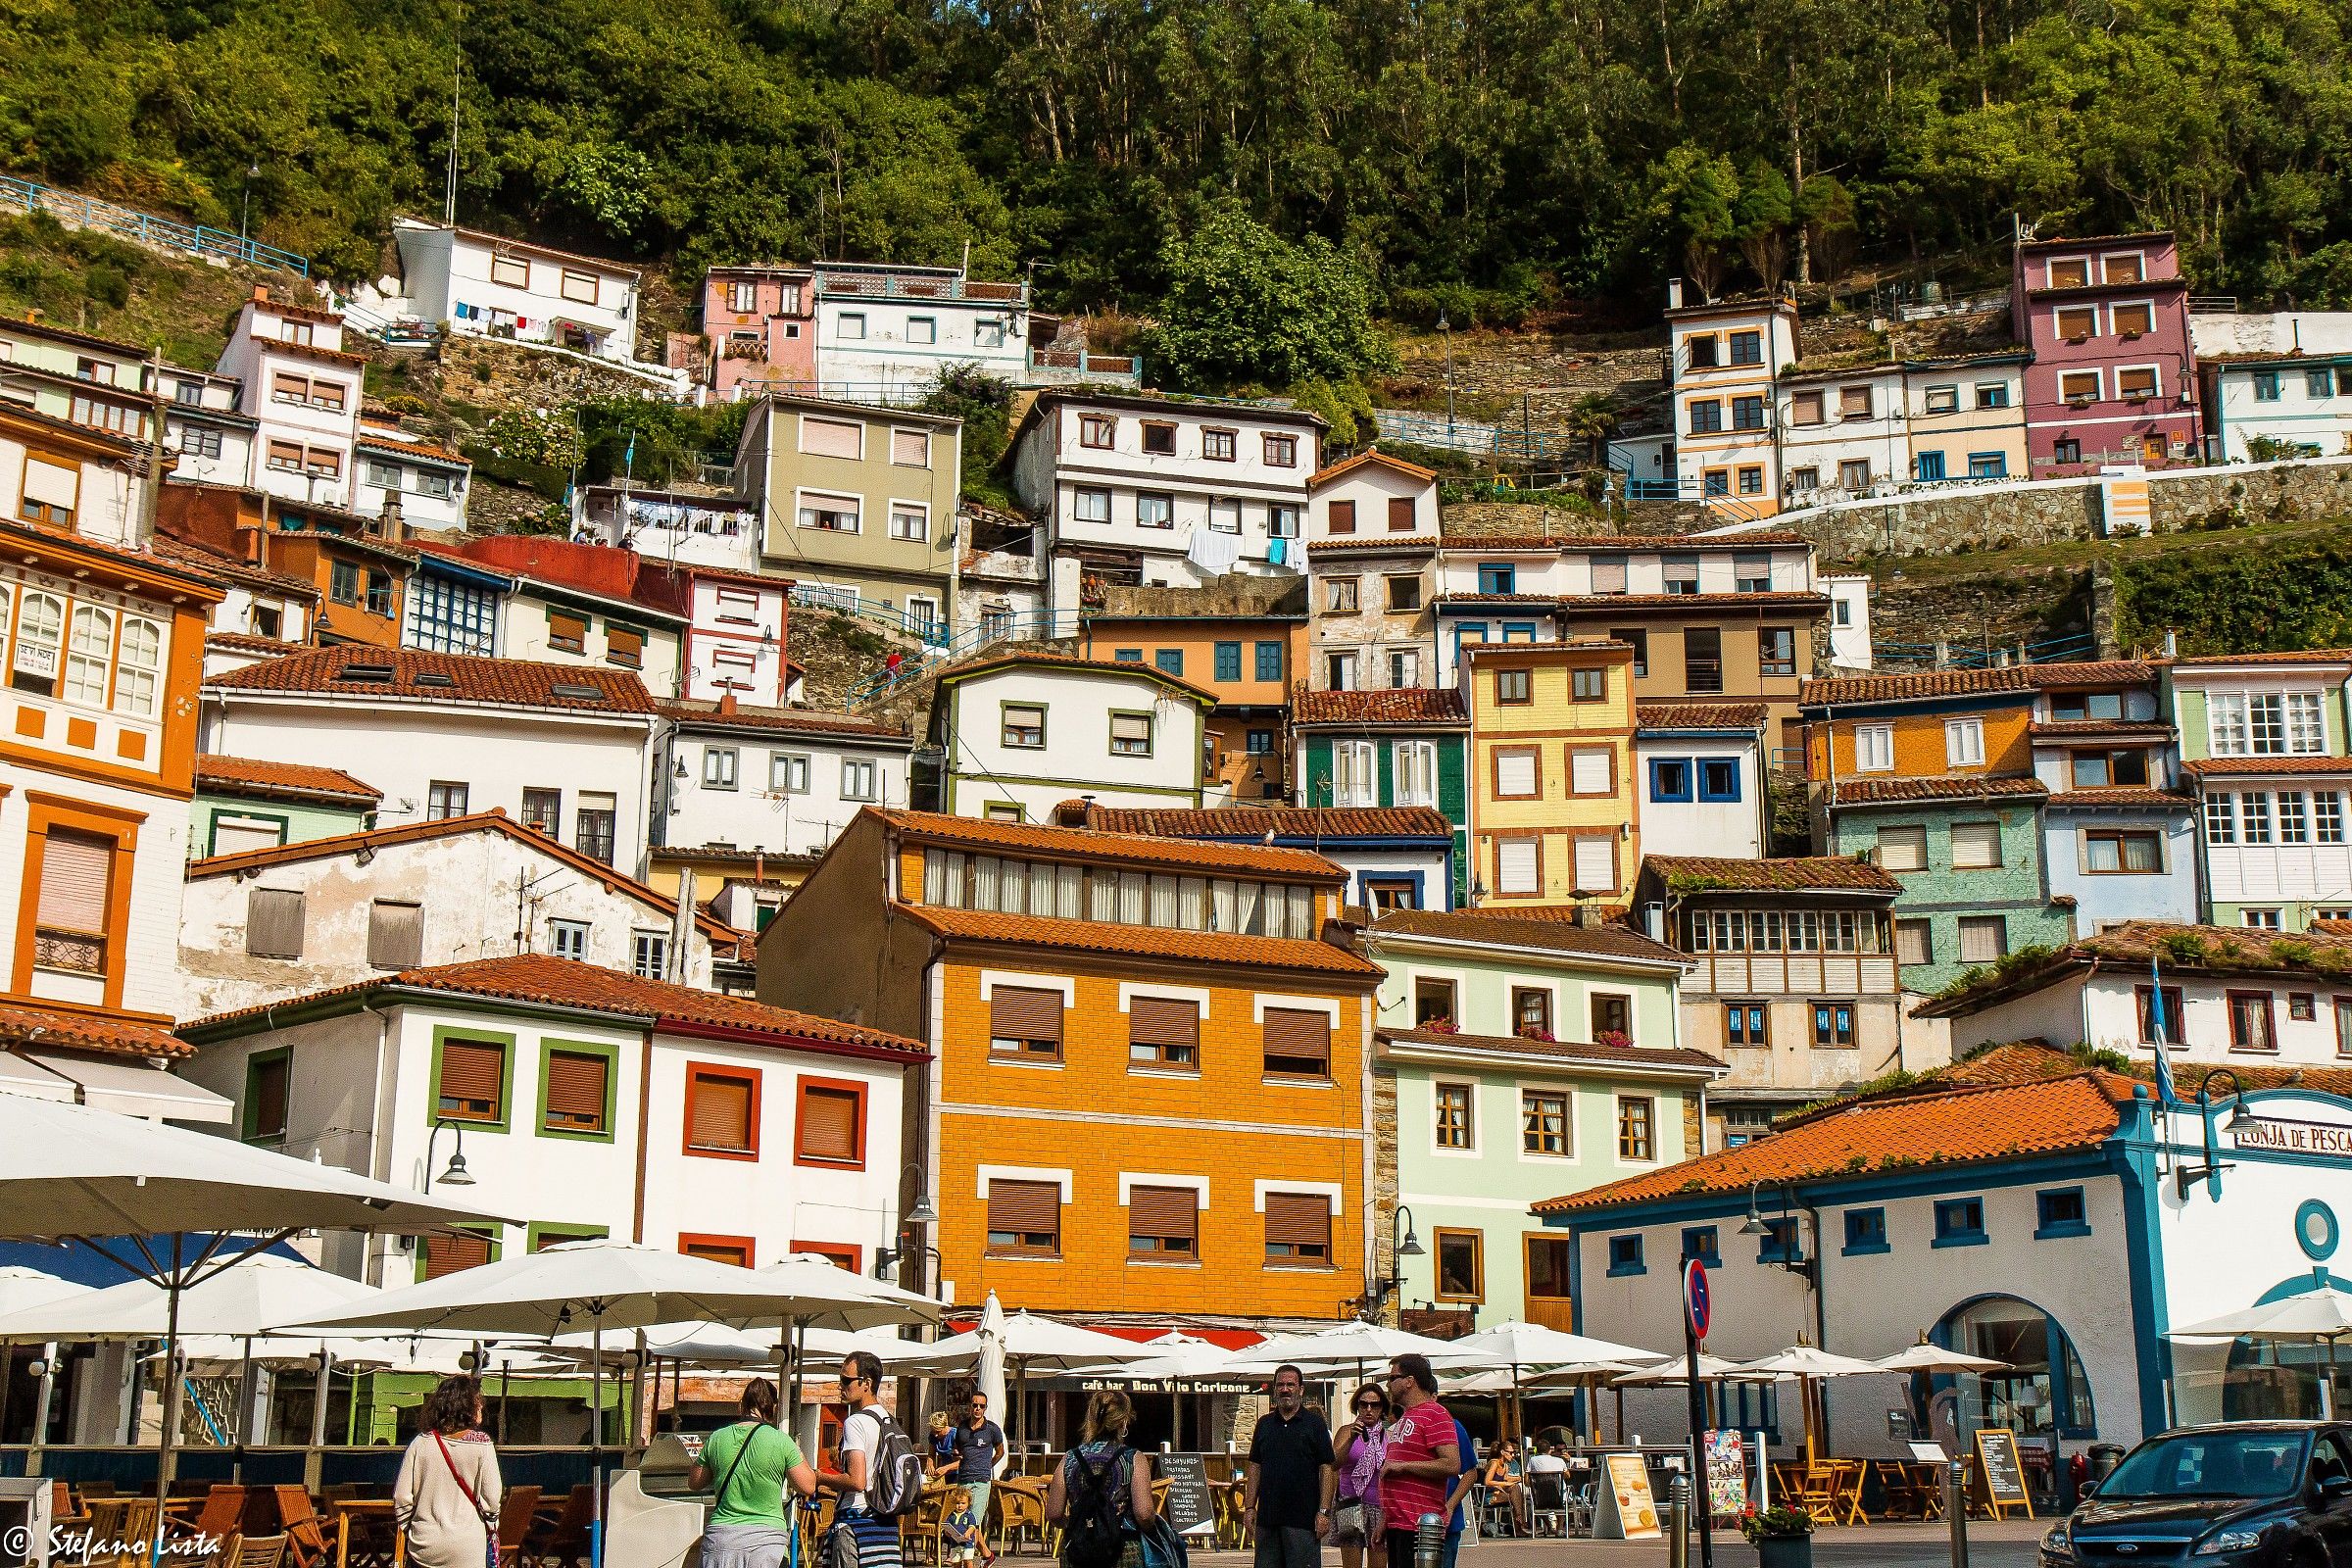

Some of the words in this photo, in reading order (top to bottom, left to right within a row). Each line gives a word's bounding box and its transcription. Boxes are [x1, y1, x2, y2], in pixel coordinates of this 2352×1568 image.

[2291, 1129, 2307, 1149] DE
[1105, 1380, 1124, 1391] bar
[1132, 1380, 1157, 1392] Don
[1162, 1378, 1189, 1393] Vito
[1194, 1380, 1250, 1393] Corleone
